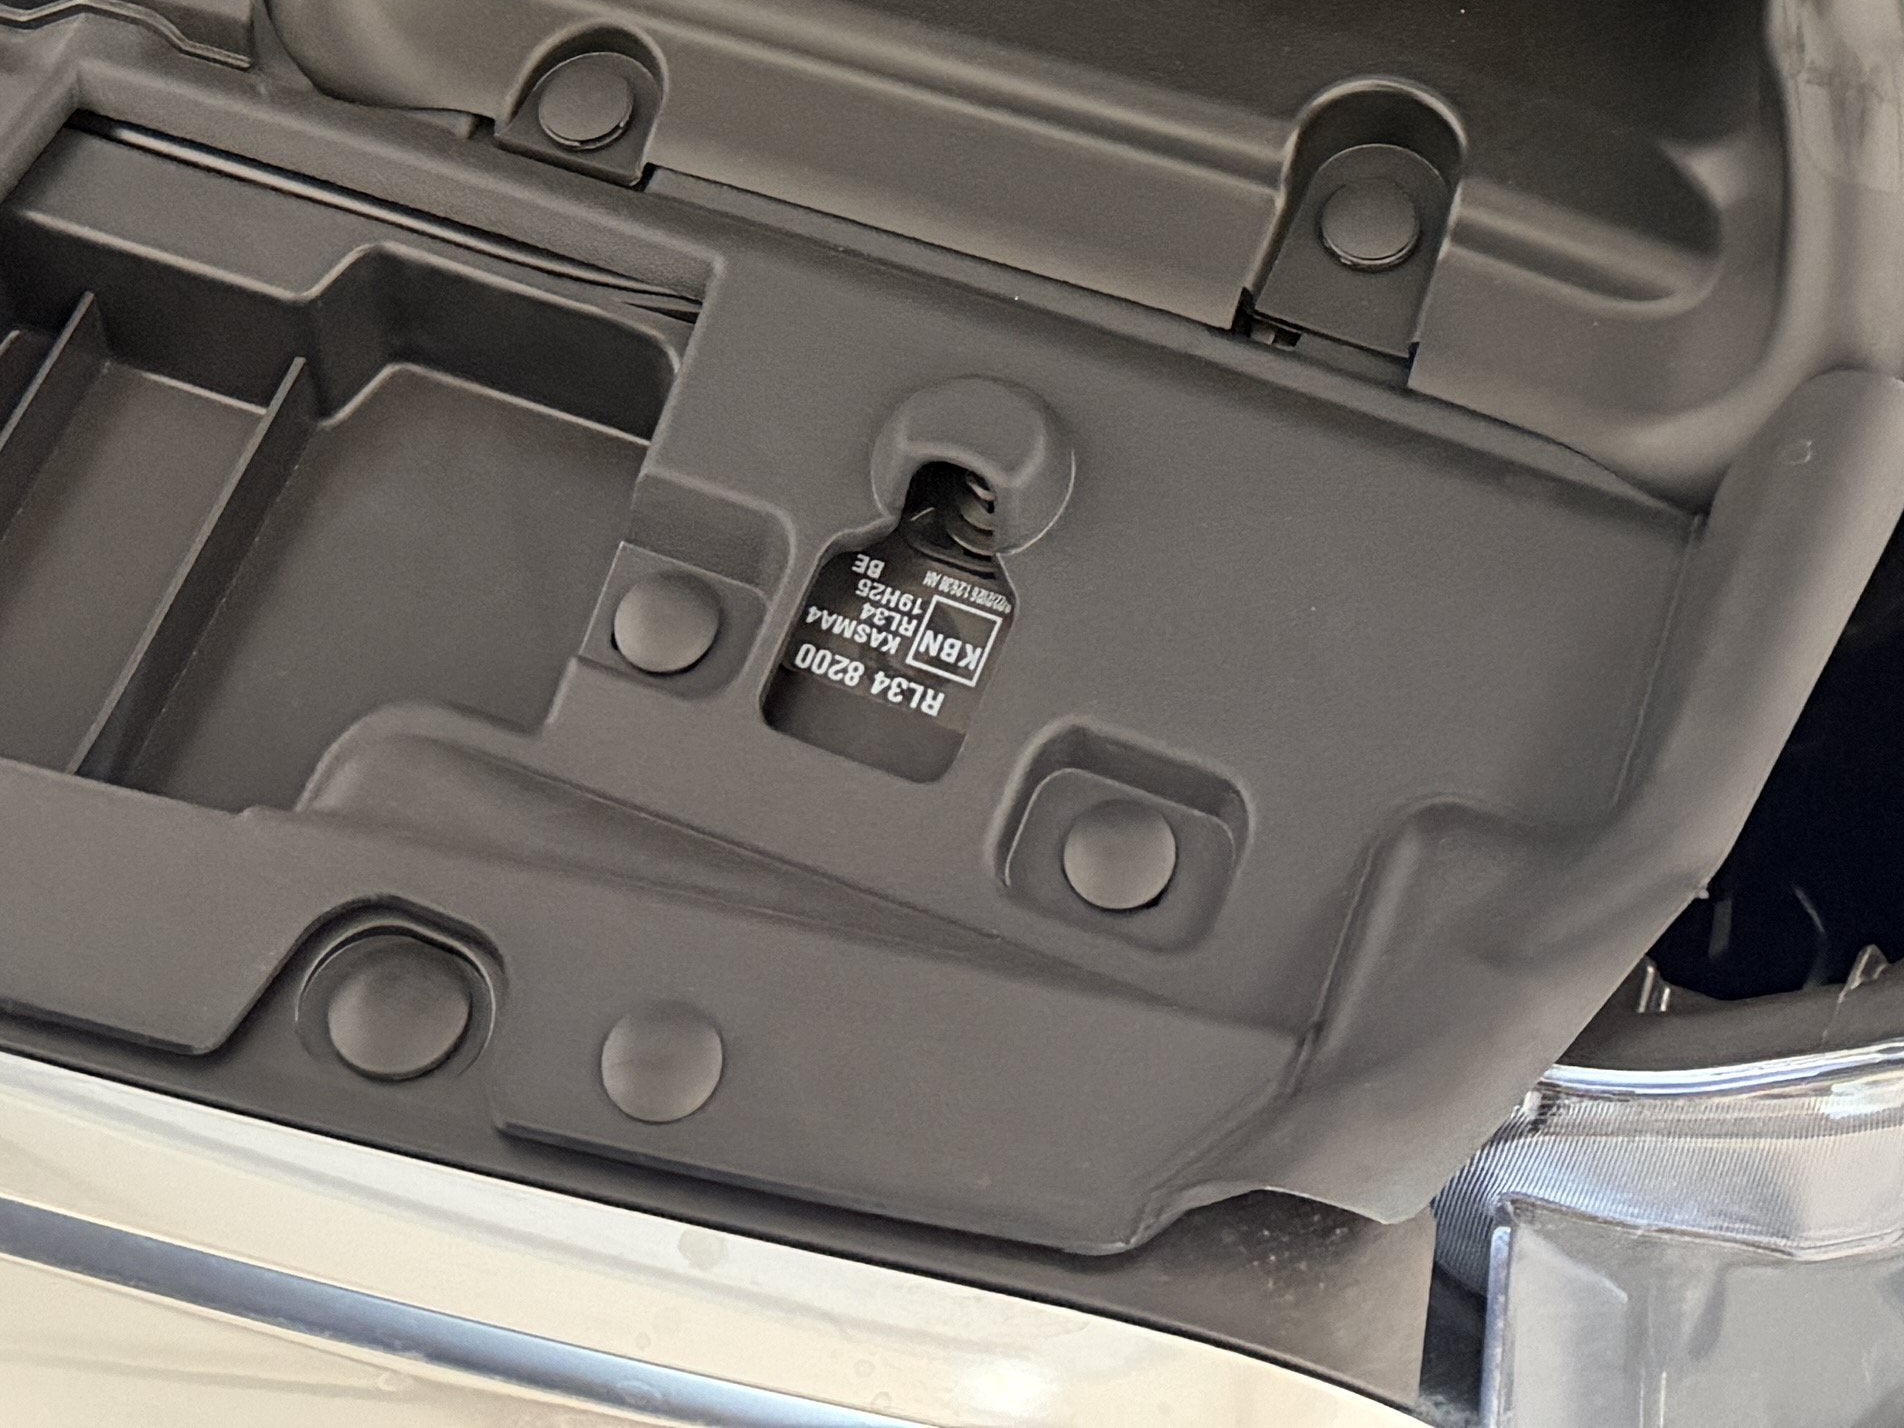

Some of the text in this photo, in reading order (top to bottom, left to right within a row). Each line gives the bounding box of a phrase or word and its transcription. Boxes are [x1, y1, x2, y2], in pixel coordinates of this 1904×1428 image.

[850, 553, 886, 579] BE
[922, 570, 941, 588] AM
[855, 578, 923, 616] 19H25
[804, 605, 902, 655] KASMA4
[859, 602, 918, 637] RL34
[918, 629, 983, 671] KBN
[794, 643, 946, 717] RL34 8200
